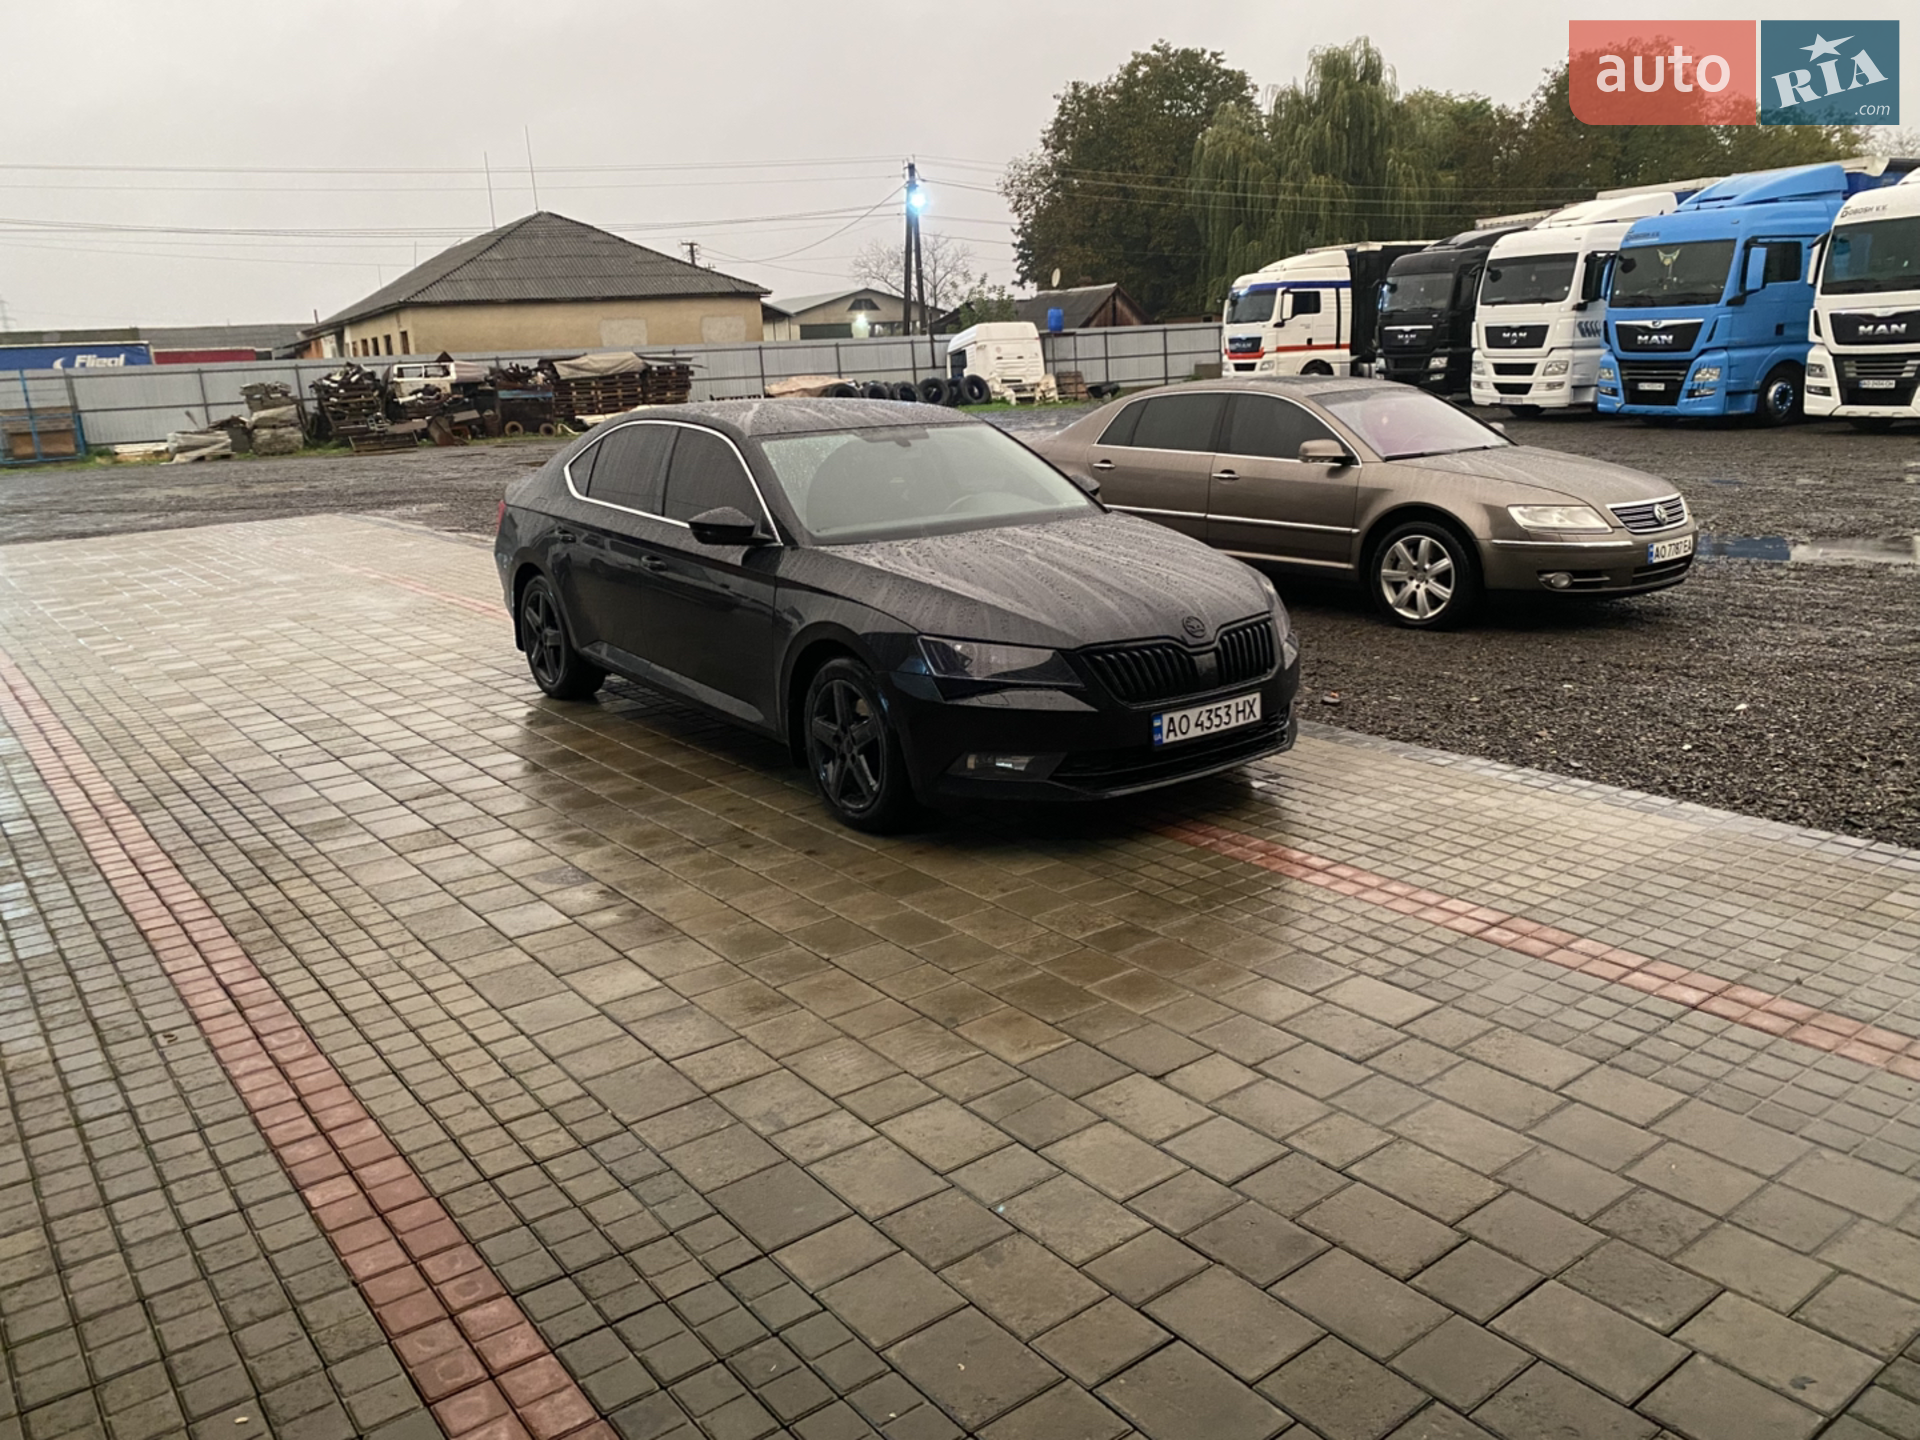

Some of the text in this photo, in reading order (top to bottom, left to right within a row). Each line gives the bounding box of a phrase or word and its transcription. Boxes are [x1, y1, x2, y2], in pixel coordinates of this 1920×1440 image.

[1858, 323, 1907, 335] MAN
[1637, 334, 1673, 344] MAN
[1654, 545, 1666, 560] AO
[1165, 697, 1257, 739] AO 4353 HX
